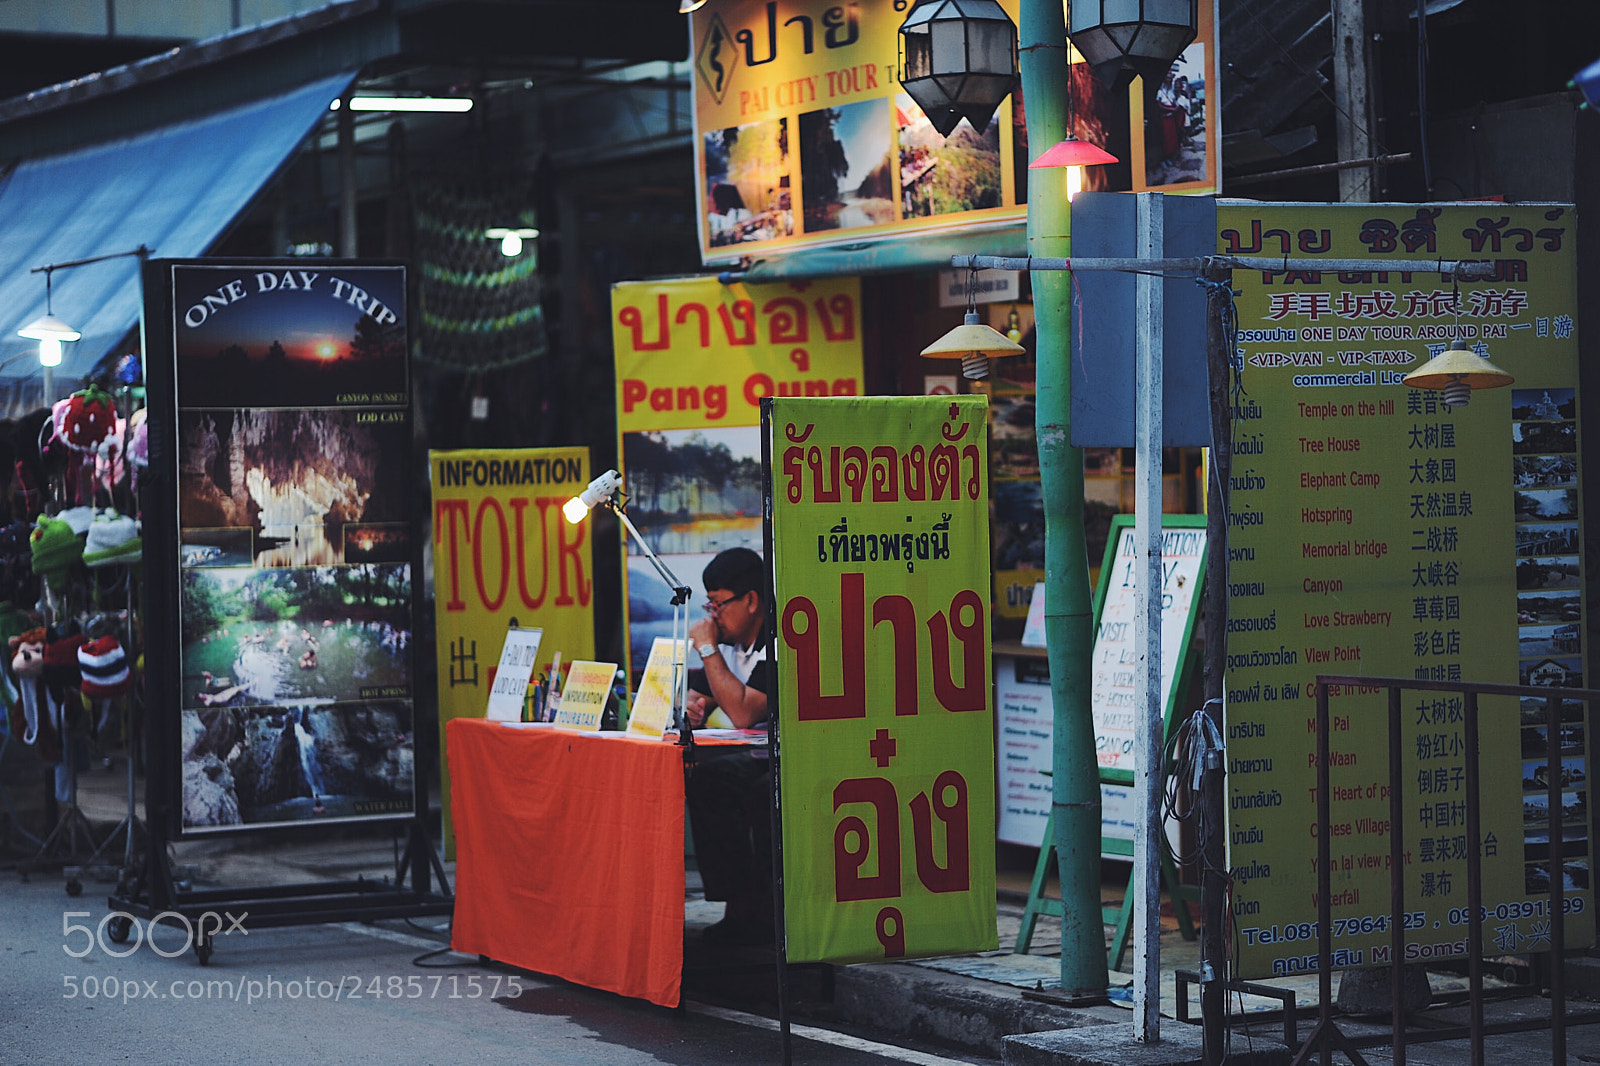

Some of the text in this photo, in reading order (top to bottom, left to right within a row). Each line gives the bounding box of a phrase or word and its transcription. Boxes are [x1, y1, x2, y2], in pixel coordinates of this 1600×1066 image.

[739, 86, 769, 115] PAI
[775, 75, 819, 108] CITY
[826, 63, 878, 97] TOUR
[1221, 220, 1331, 254] ปาย
[1463, 208, 1565, 252] ทัวร์
[185, 270, 397, 328] ONE DAY TRIP
[1301, 328, 1333, 341] ONE
[1337, 327, 1368, 340] DAY
[1371, 326, 1413, 340] TOUR
[1417, 325, 1478, 339] AROUND
[1482, 324, 1508, 338] PAI
[1293, 371, 1410, 386] commercial Lice
[623, 379, 727, 421] Pang
[1298, 399, 1394, 420] Temple on the hill
[1299, 436, 1360, 453] Tree House
[1408, 423, 1456, 450] 大树屋
[783, 402, 981, 504] รับจองตั๋ว
[439, 457, 582, 487] INFORMATION
[1300, 471, 1380, 491] Elephant Camp
[1409, 457, 1456, 484] 大象园
[1301, 506, 1353, 526] Hotspring
[1410, 491, 1473, 519] 天然温泉
[818, 513, 953, 574] เที่ยวพรุ่งนี้
[1302, 539, 1388, 559] Memorial bridge
[1411, 526, 1458, 553] 二战桥
[436, 496, 592, 613] TOUR
[1303, 577, 1343, 596] Canyon
[1412, 560, 1459, 587] 大峡谷
[1304, 609, 1392, 628] Love Strawberry
[1413, 595, 1460, 622] 草莓园
[782, 572, 987, 722] ปาง
[1305, 645, 1361, 663] View Point
[1413, 628, 1460, 656] 彩色店
[1334, 715, 1350, 731] Pai
[1333, 785, 1363, 801] Heart
[1366, 782, 1378, 799] of
[1417, 767, 1465, 795] 倒房子
[1355, 817, 1391, 836] Village
[1419, 800, 1466, 829] 中国村
[833, 728, 970, 958] อุ๋ง
[1341, 855, 1354, 870] lai
[1357, 853, 1382, 869] view
[1421, 870, 1452, 898] 瀑布
